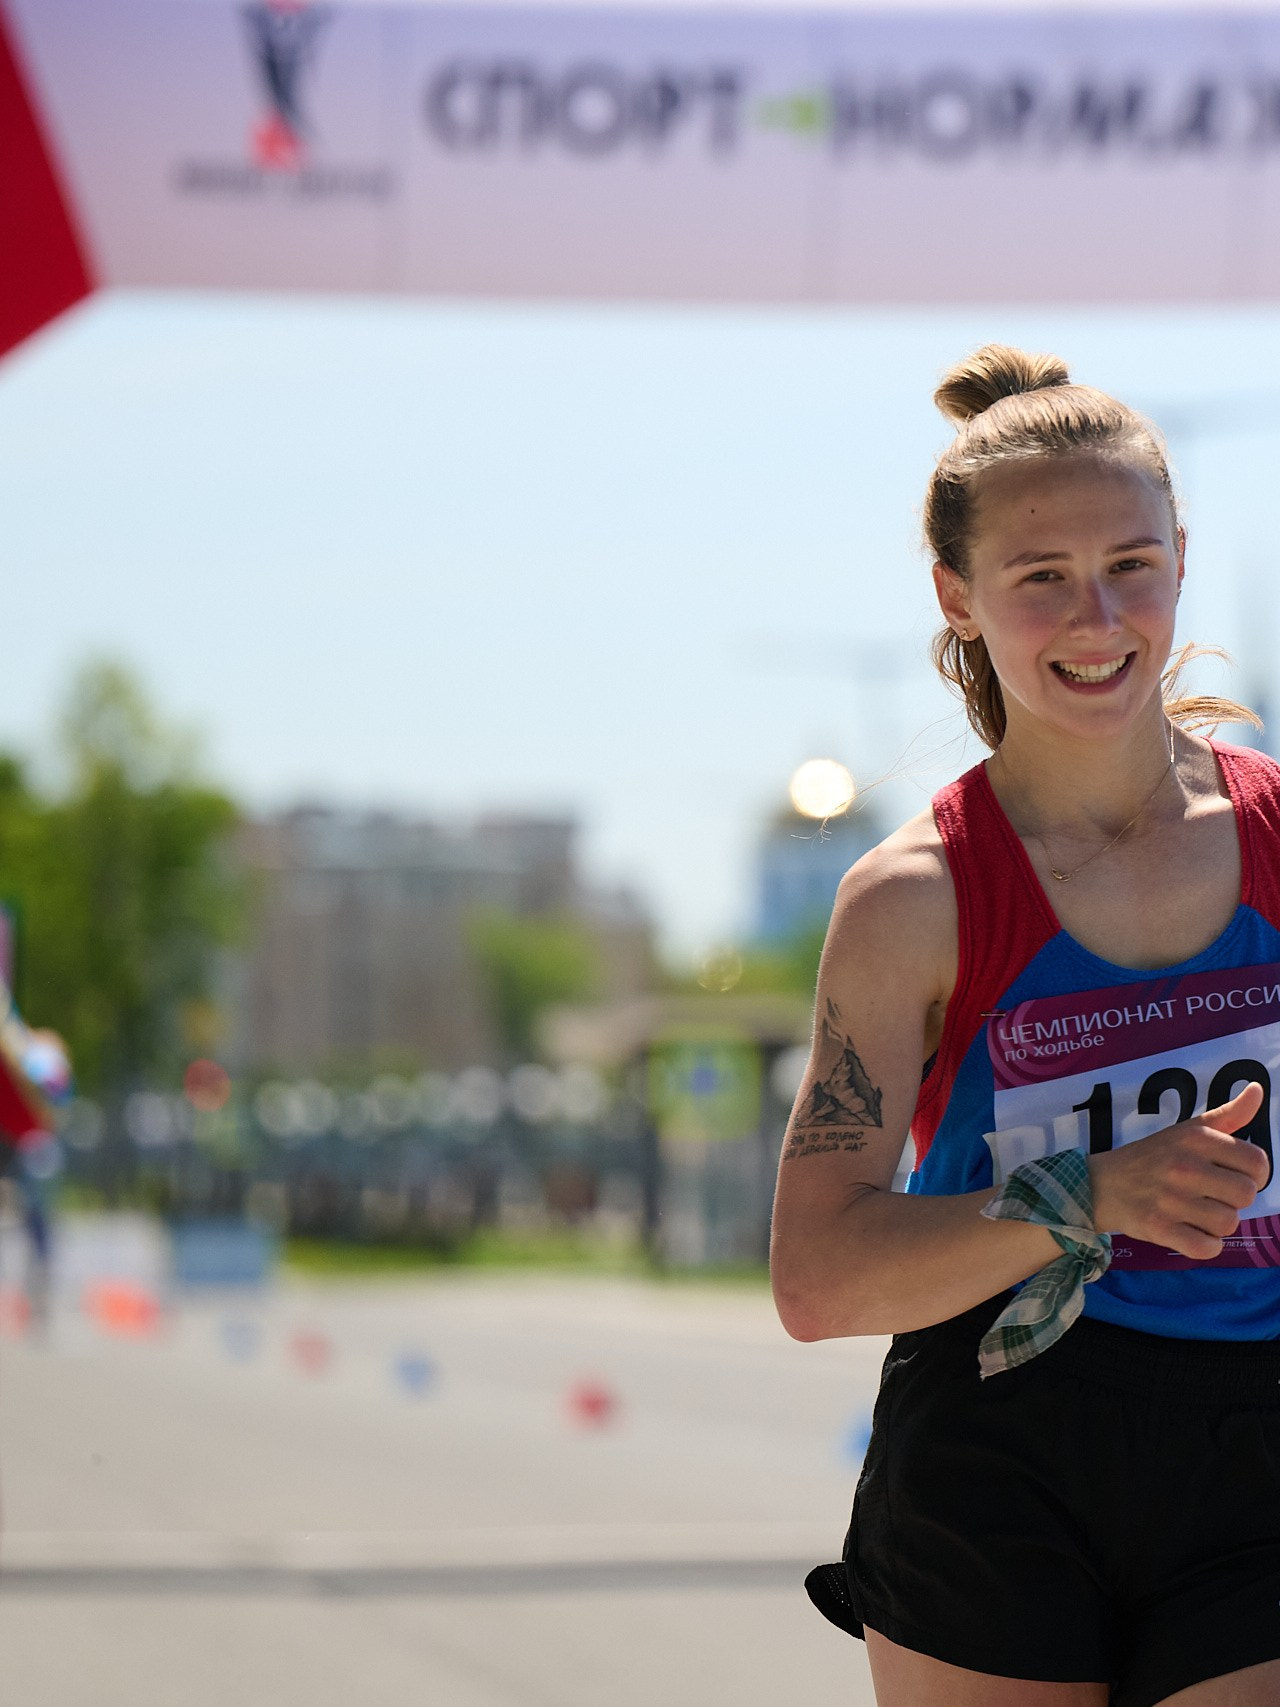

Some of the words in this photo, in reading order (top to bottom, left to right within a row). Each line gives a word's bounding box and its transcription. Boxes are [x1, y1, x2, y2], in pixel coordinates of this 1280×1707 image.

[424, 56, 744, 161] СПОРТ
[830, 60, 1222, 165] НОРМА
[1000, 999, 1177, 1045] ЧЕМПИОНАТ
[1004, 1048, 1027, 1062] по
[1033, 1033, 1105, 1057] ходьбе
[1221, 1240, 1256, 1248] ТЛЕТИКИ
